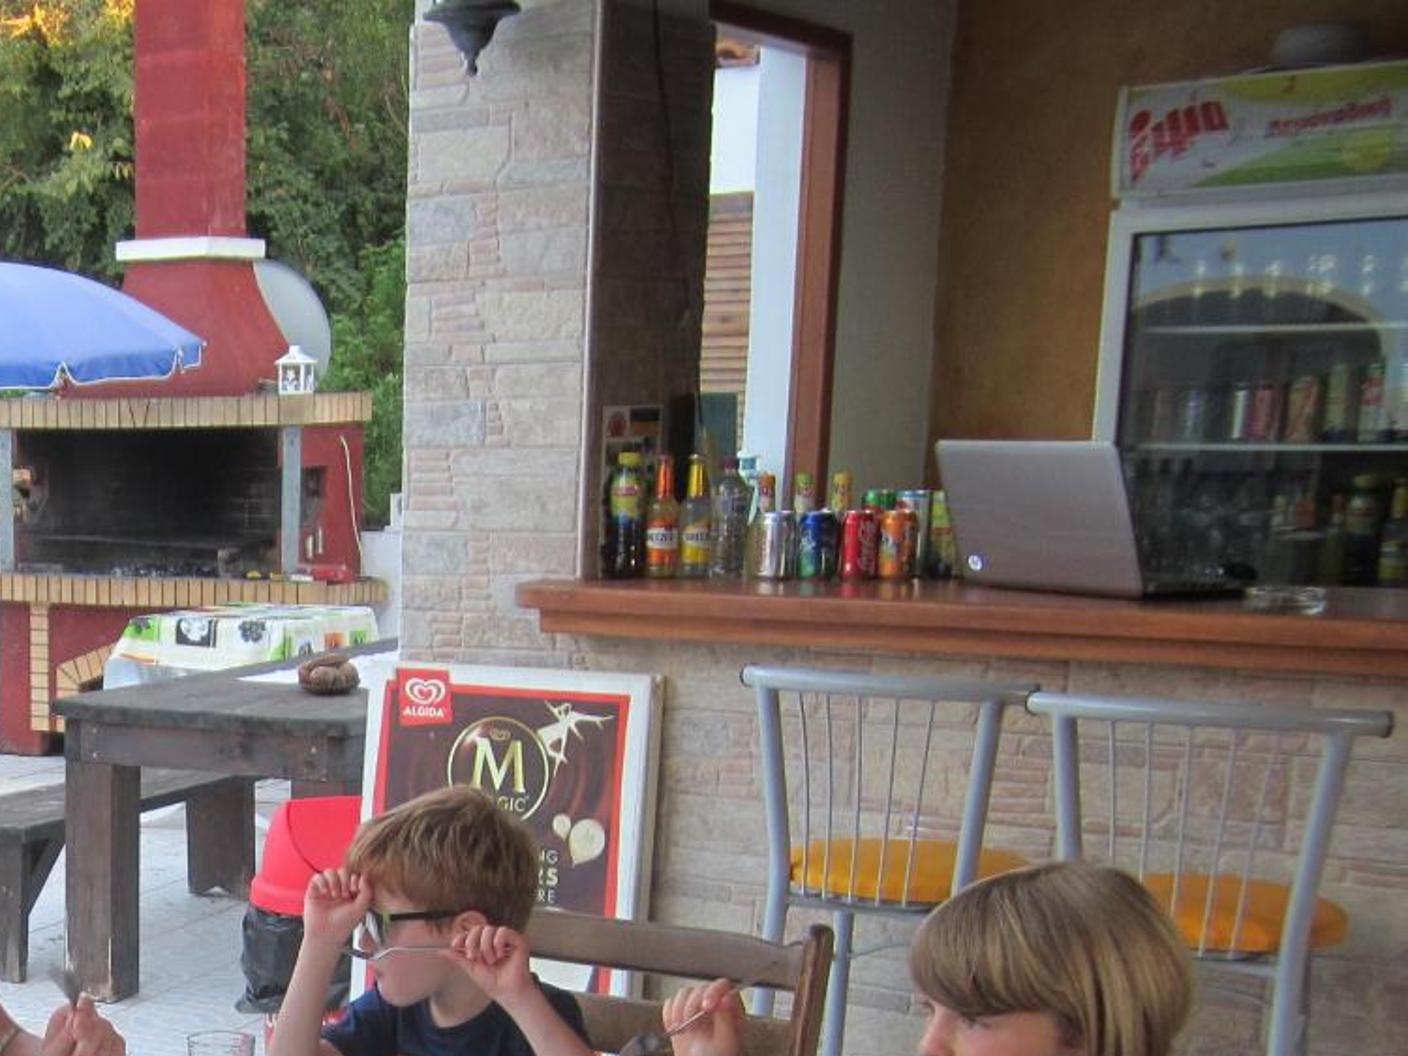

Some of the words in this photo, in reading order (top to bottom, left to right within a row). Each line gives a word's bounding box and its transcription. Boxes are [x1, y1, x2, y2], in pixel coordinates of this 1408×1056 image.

[403, 705, 445, 719] ALGIDA
[472, 736, 525, 794] M
[496, 796, 527, 812] GIC
